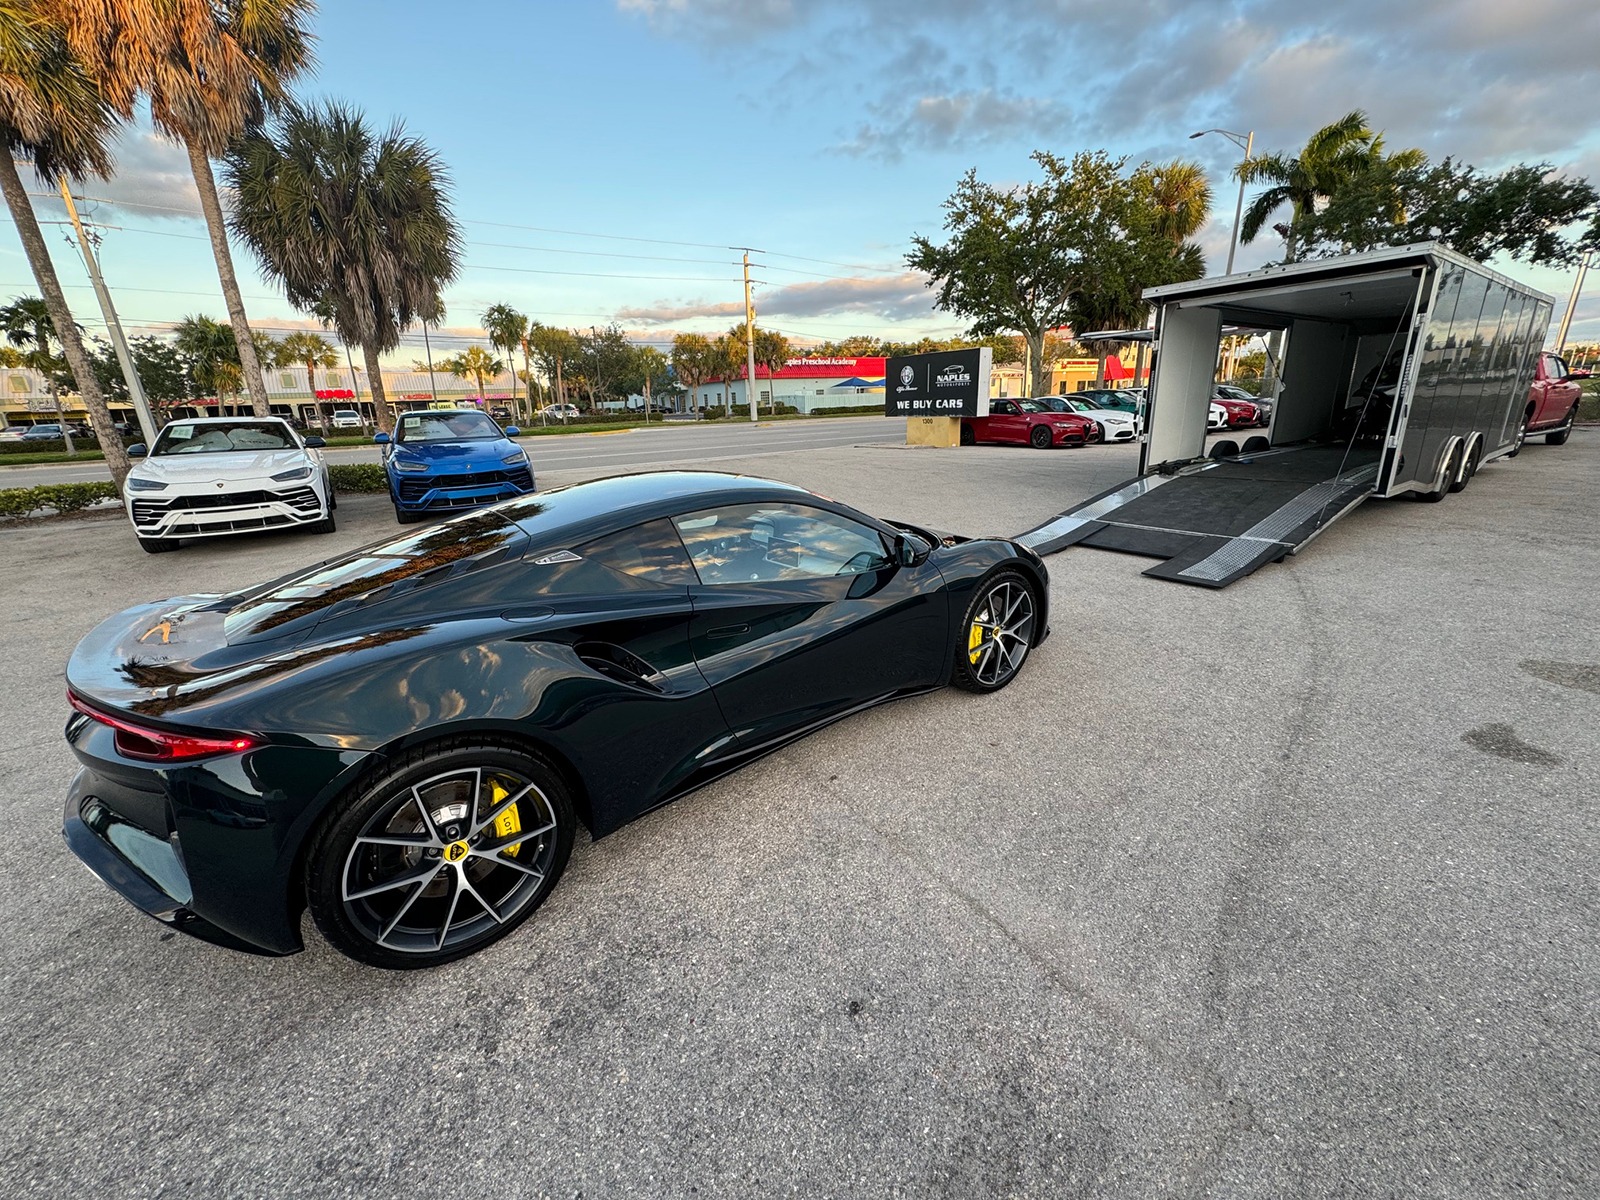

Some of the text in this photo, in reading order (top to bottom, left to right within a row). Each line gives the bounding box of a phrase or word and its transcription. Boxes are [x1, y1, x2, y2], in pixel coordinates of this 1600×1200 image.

[802, 358, 830, 366] Preschool
[831, 358, 857, 367] Academy
[936, 373, 970, 382] NAPLES
[896, 399, 963, 410] WE BUY CARS
